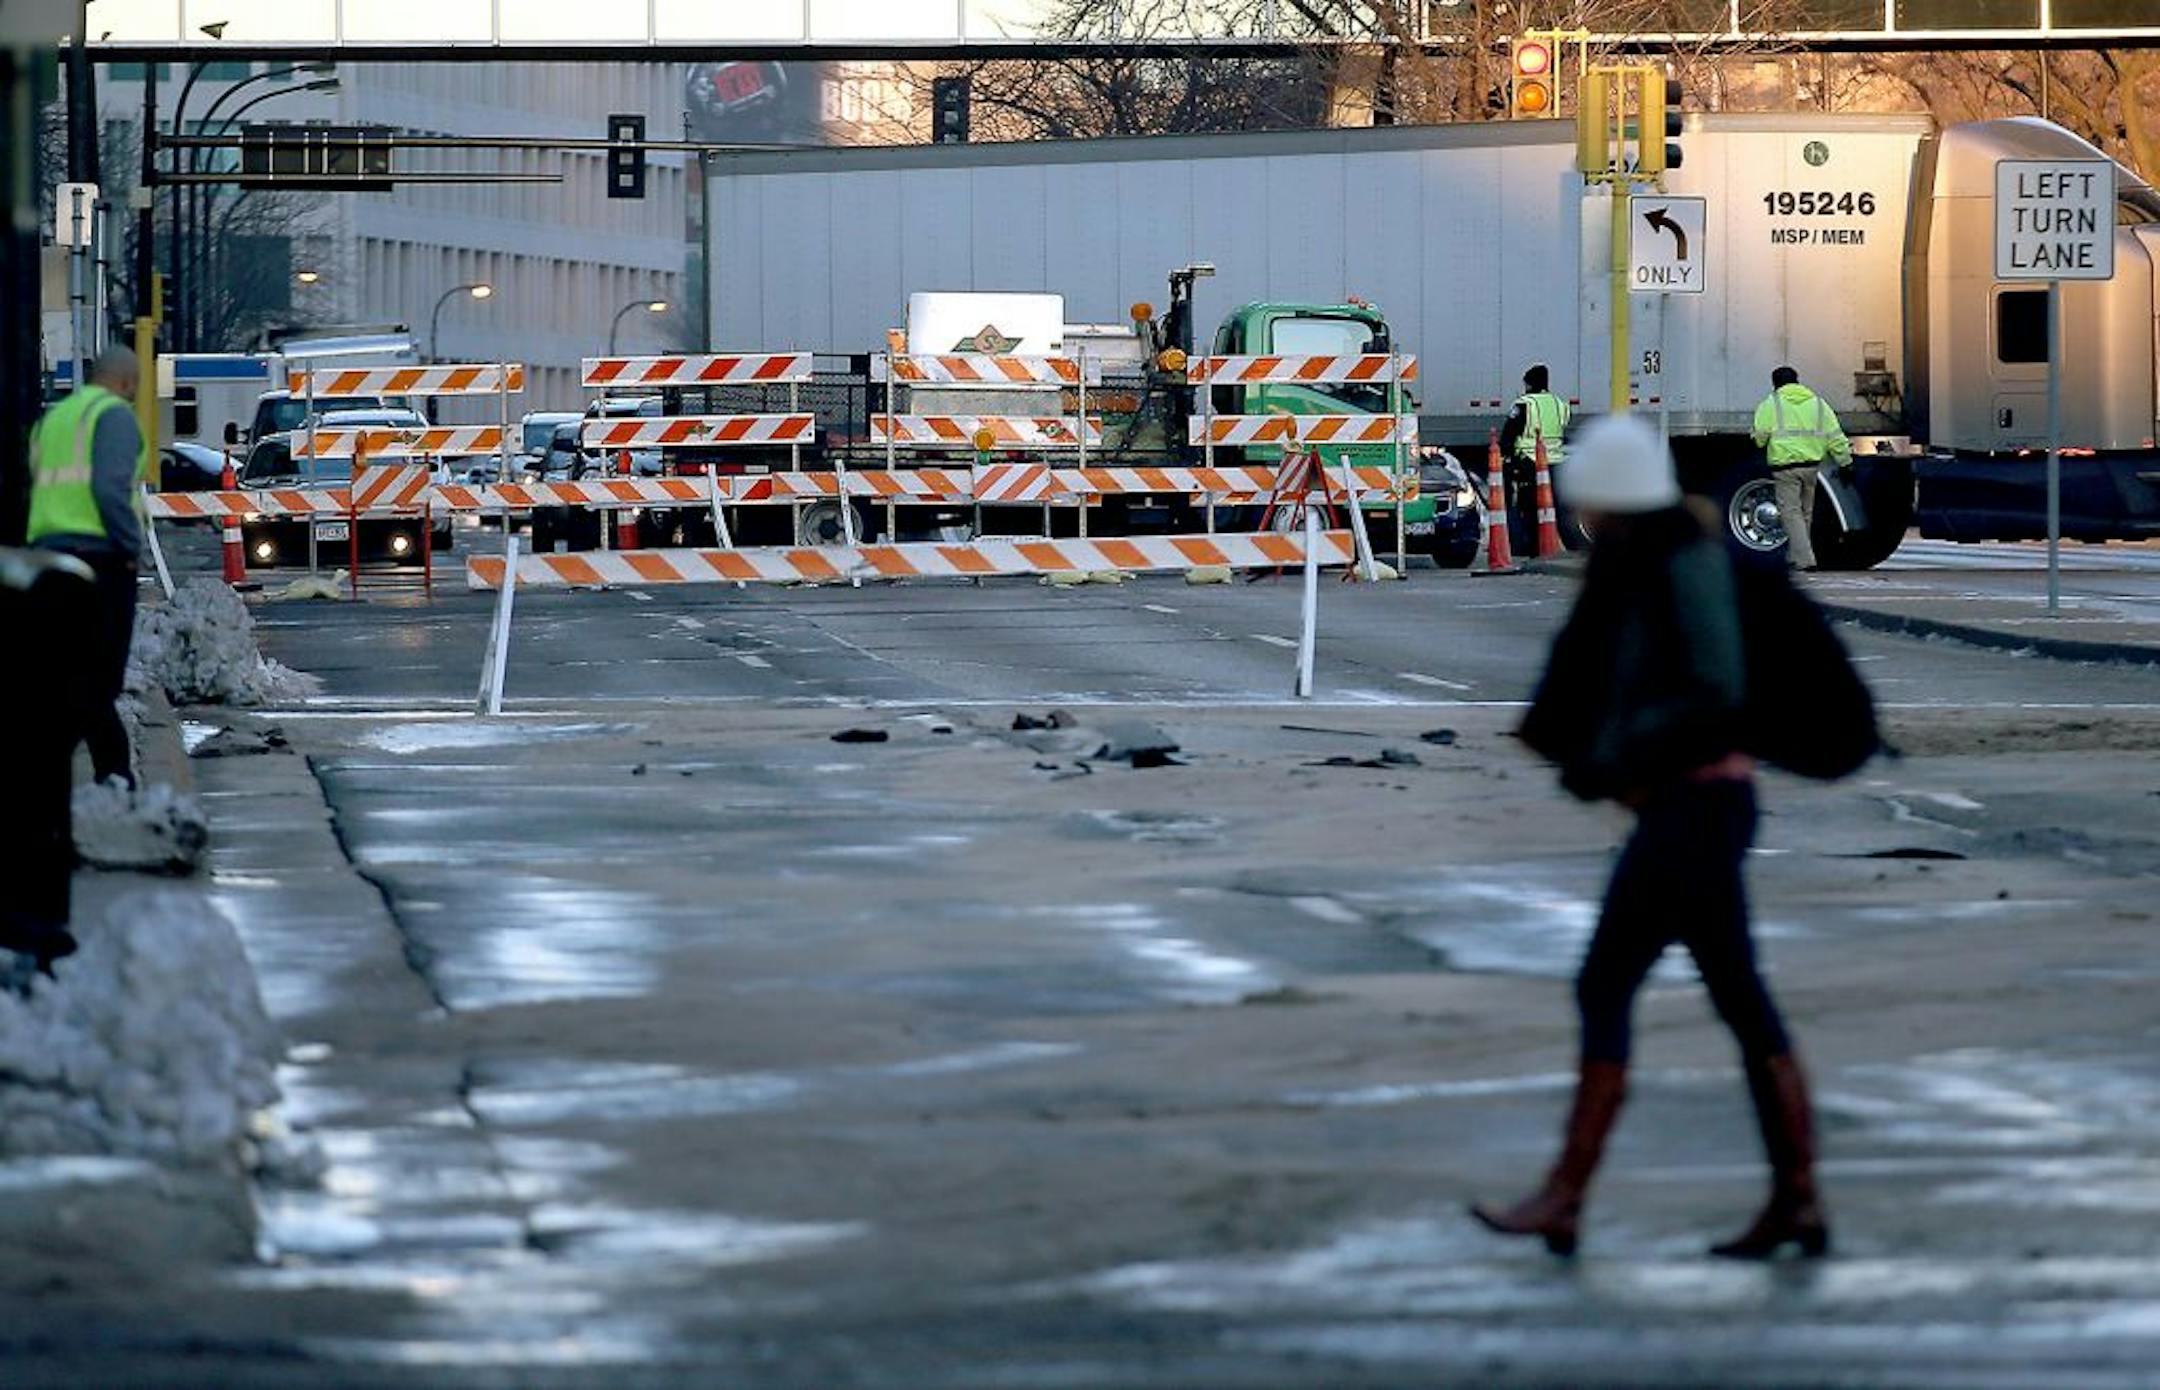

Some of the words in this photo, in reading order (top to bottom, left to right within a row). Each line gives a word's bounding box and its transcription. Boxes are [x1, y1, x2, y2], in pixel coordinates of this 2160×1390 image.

[2018, 172, 2096, 199] LEFT
[1763, 191, 1876, 216] 195246
[2011, 207, 2096, 234] TURN
[2010, 242, 2095, 269] LANE
[1636, 265, 1692, 284] ONLY
[1643, 350, 1661, 375] 53
